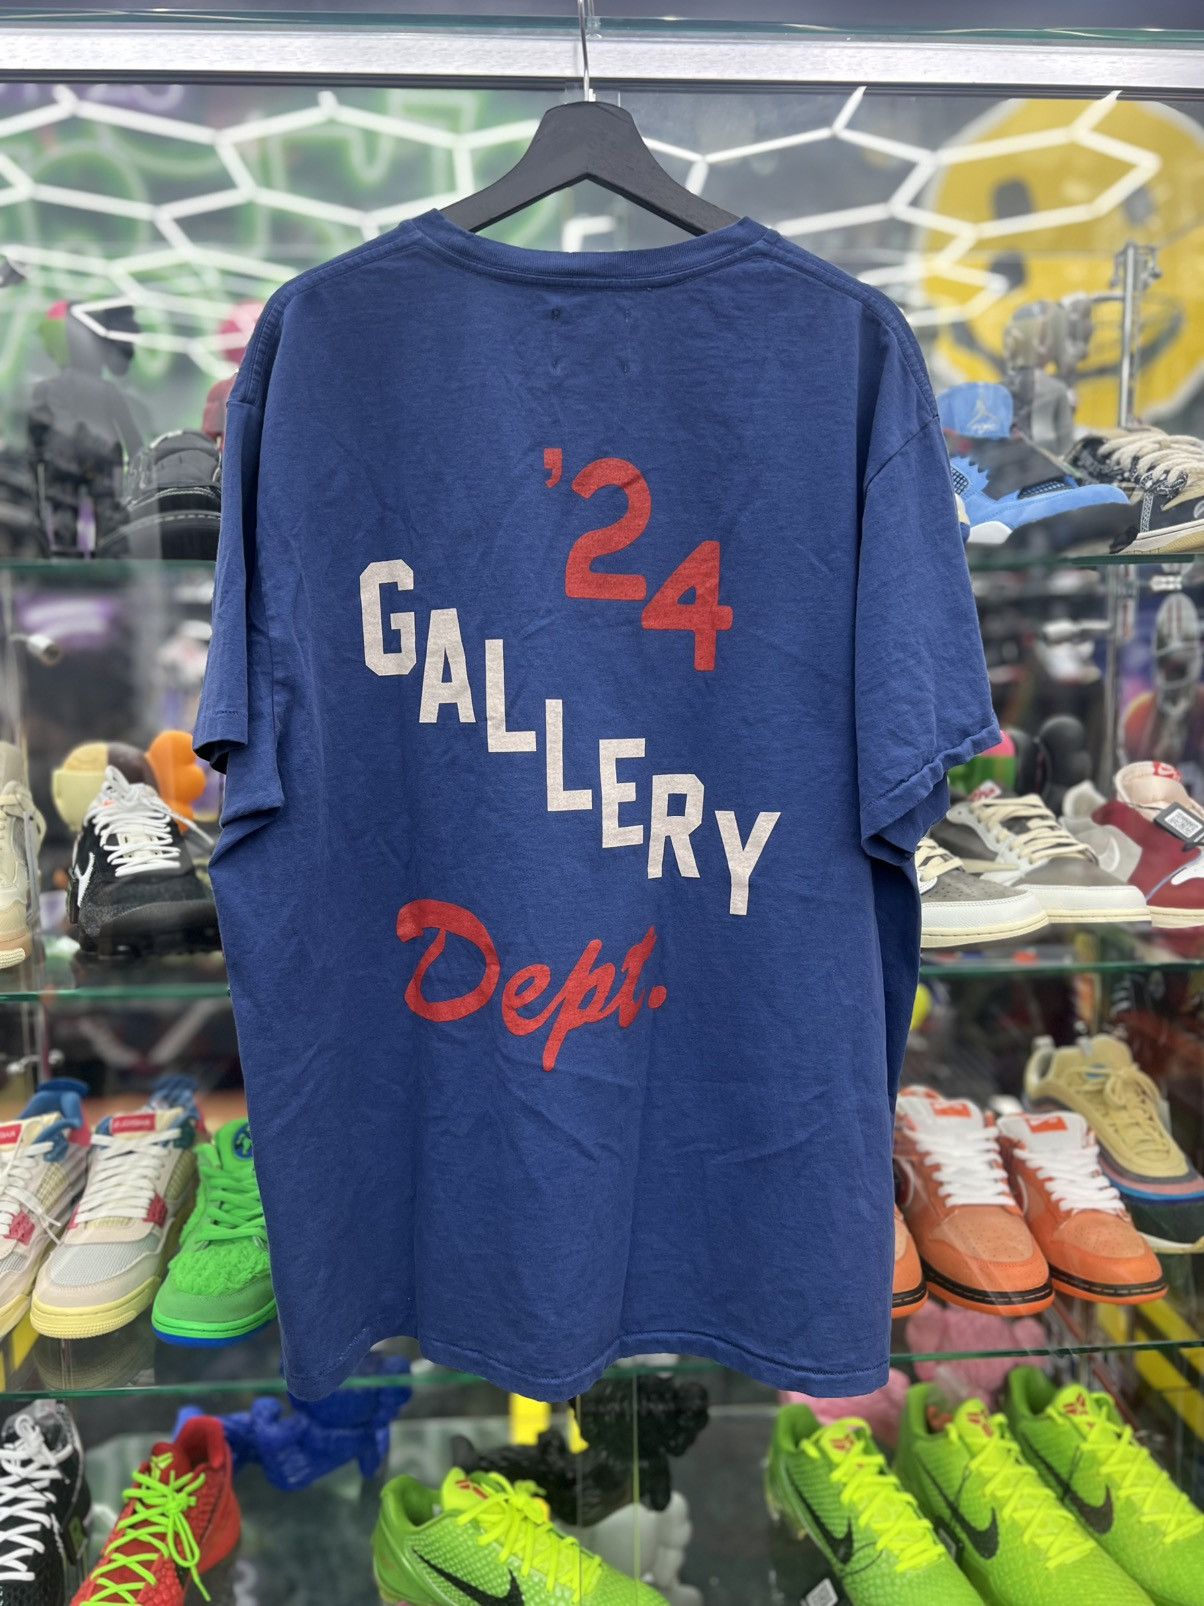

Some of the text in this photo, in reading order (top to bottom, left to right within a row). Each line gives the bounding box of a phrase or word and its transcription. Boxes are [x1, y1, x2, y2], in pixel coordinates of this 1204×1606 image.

[544, 447, 734, 672] '24
[359, 559, 781, 916] GALLERY
[396, 899, 667, 1072] Dept.
